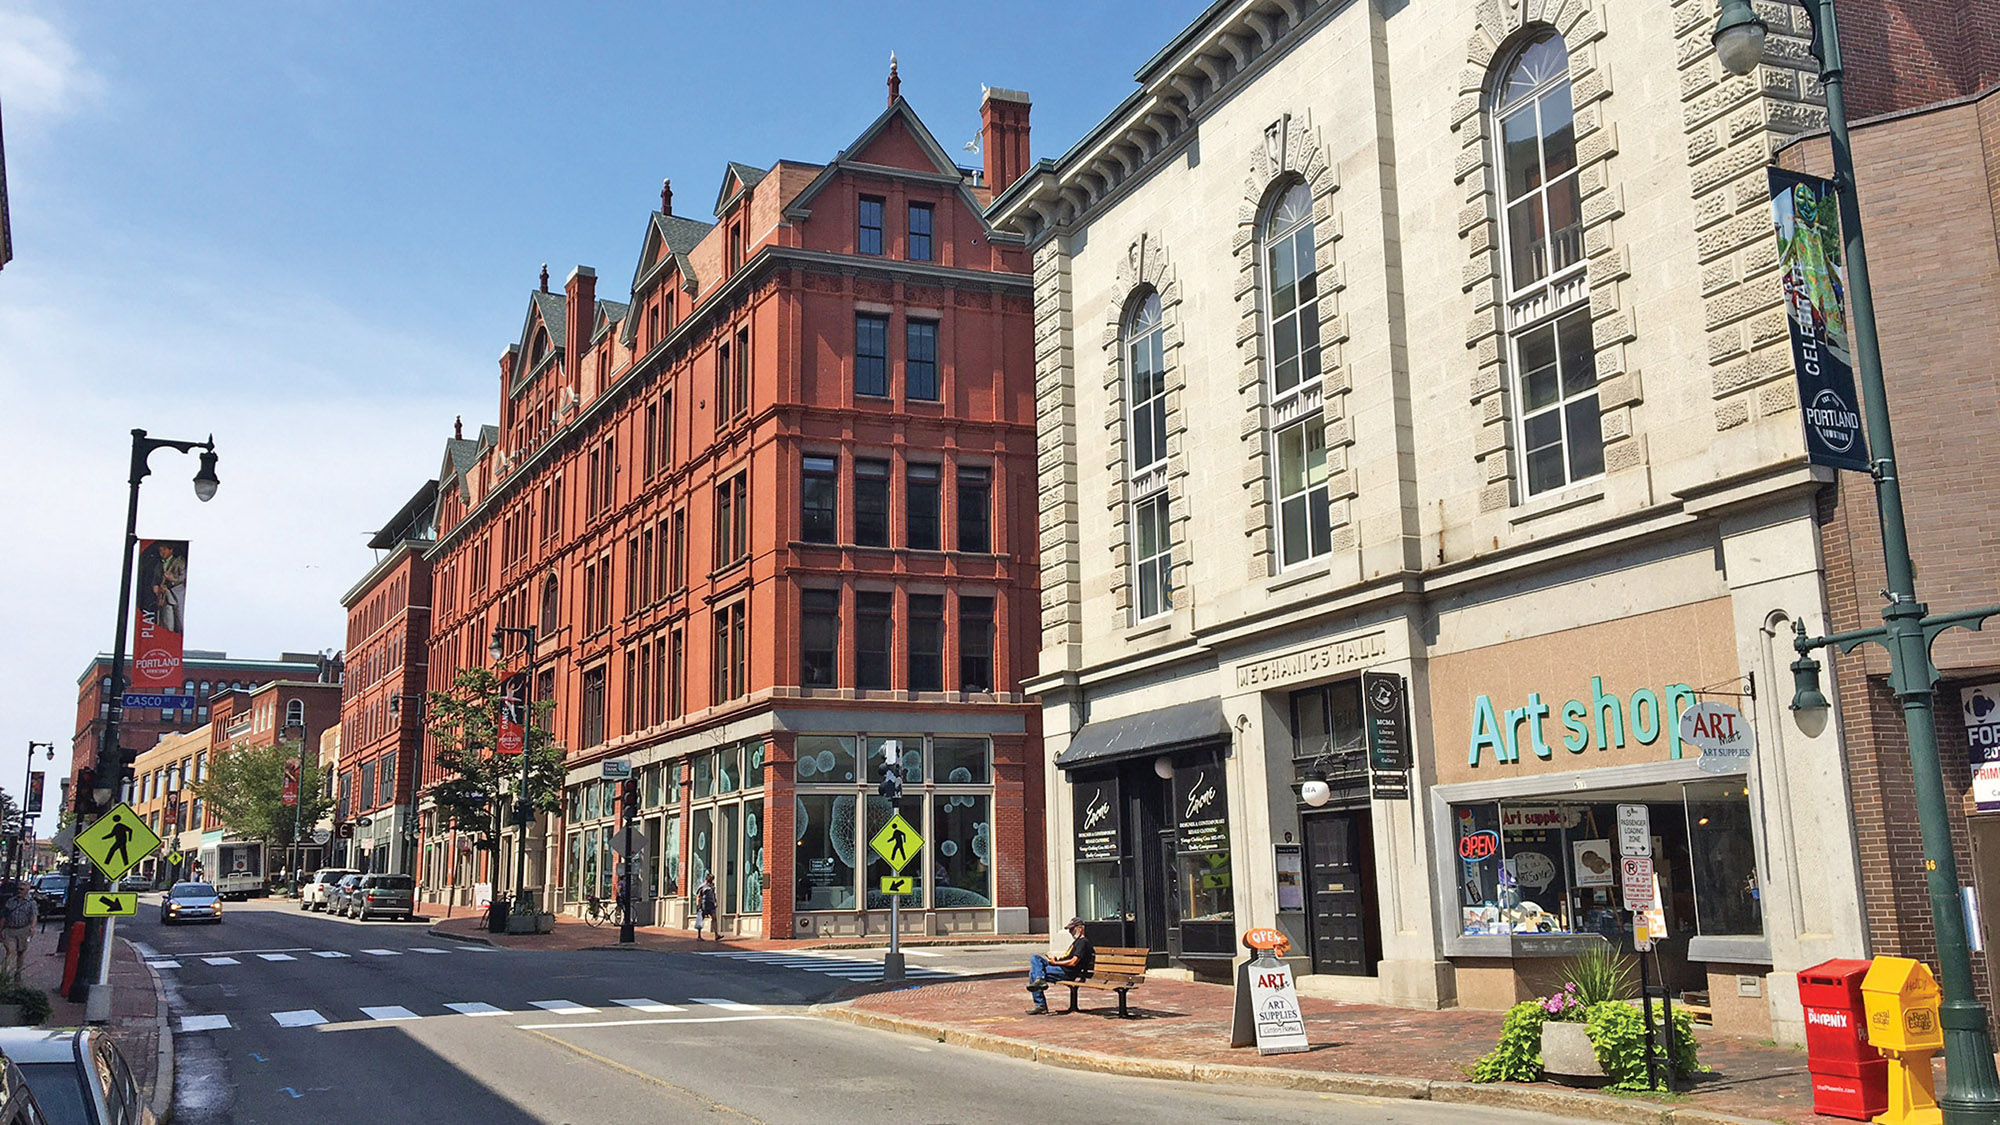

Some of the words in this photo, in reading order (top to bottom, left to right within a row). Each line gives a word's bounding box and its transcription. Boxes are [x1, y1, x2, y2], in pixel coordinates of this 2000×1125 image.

[1806, 407, 1859, 429] PORTLAND
[141, 609, 156, 638] PLAY
[136, 657, 180, 669] PORTLAND
[126, 695, 162, 706] CASCO
[1468, 693, 1551, 766] Art
[1562, 676, 1696, 760] shop
[1693, 712, 1736, 738] ART
[1717, 730, 1742, 746] Mart
[1703, 748, 1718, 757] ART
[1718, 748, 1750, 757] SUPPLIES
[1973, 767, 2000, 781] PRIM
[1503, 809, 1522, 825] Art
[1460, 835, 1496, 857] OPEN
[1252, 930, 1281, 944] OPEN
[1258, 973, 1285, 988] ART
[1268, 1000, 1285, 1010] ART
[1259, 1010, 1298, 1021] SUPPLIES
